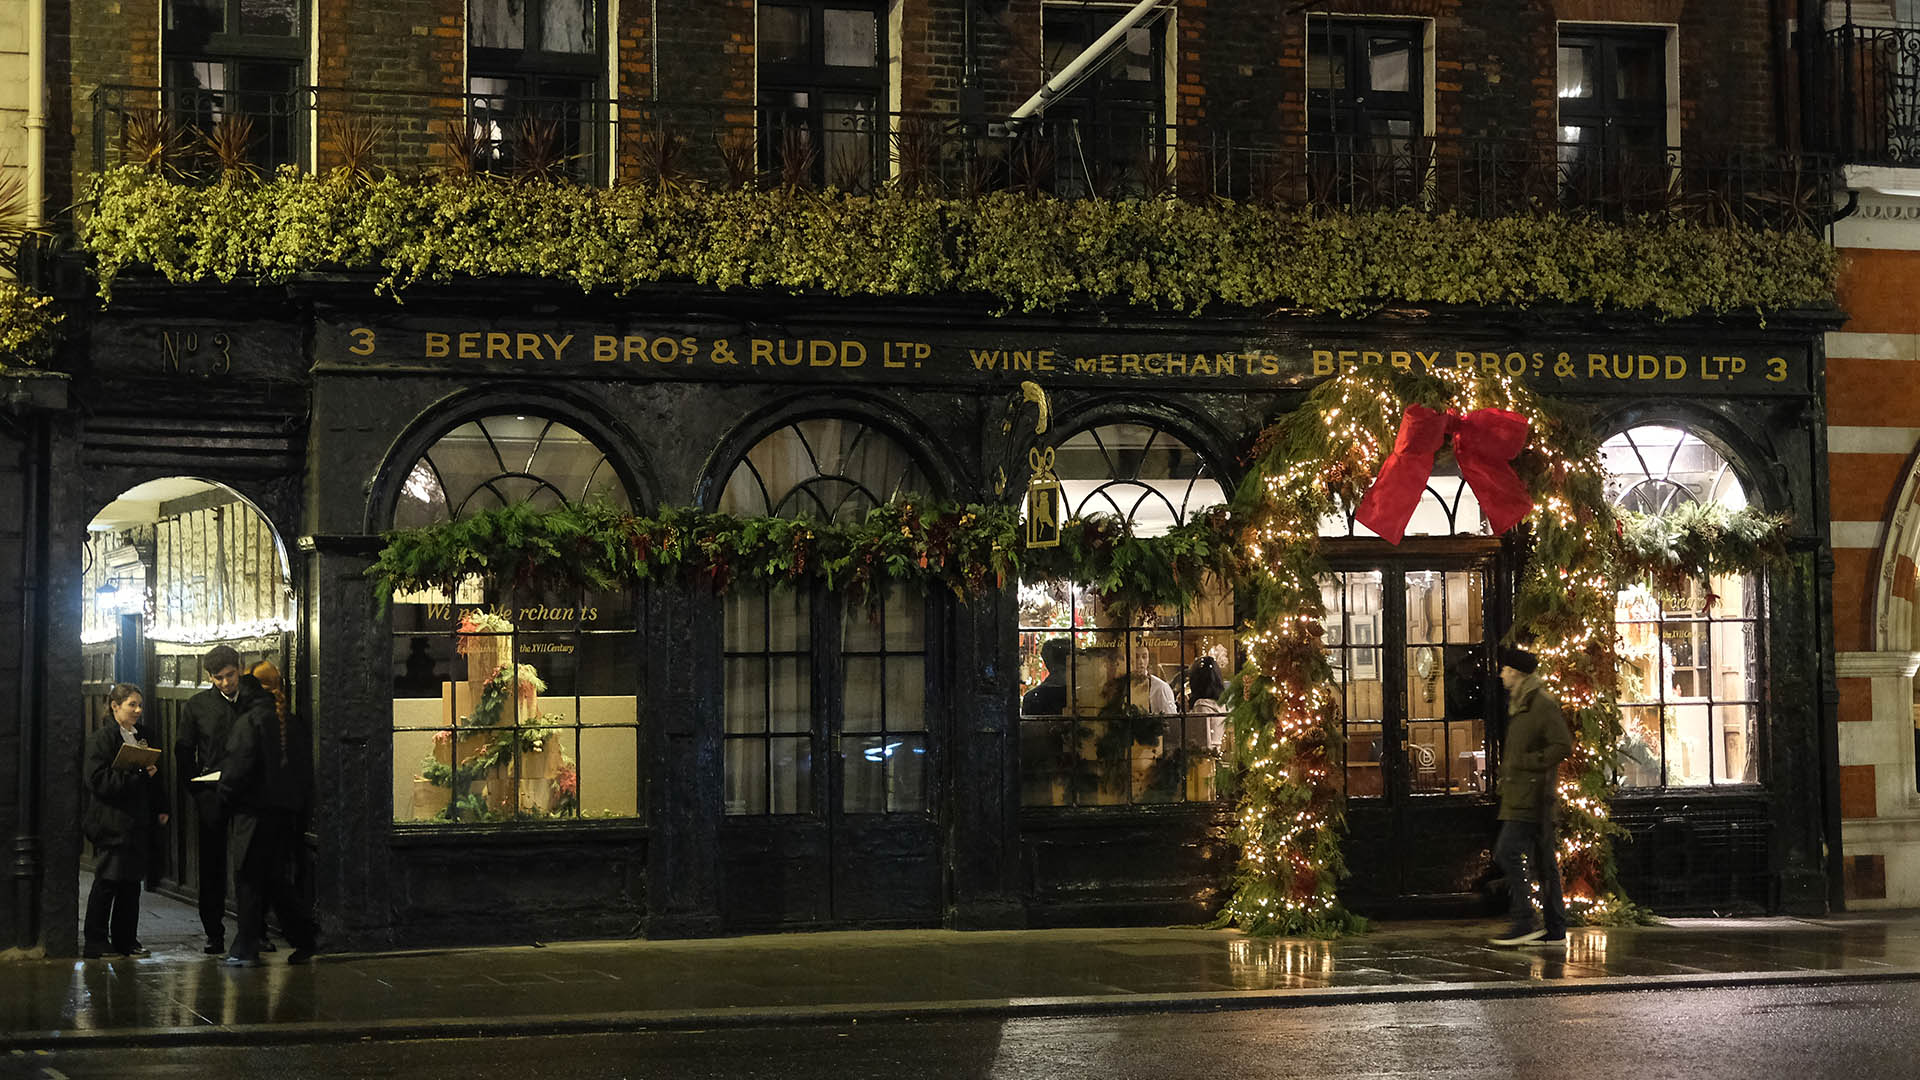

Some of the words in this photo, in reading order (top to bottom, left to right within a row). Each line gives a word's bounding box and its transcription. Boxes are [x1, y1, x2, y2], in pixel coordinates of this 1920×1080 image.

[212, 332, 231, 375] 3
[349, 328, 376, 356] 3
[426, 332, 574, 360] BERRY
[710, 339, 739, 365] &
[751, 339, 867, 367] RUDD
[969, 349, 1056, 371] WINE
[1075, 353, 1279, 376] MERCHANTS
[1553, 352, 1576, 377] &
[1588, 353, 1688, 380] RUDD
[1765, 357, 1788, 382] 3
[547, 643, 575, 654] Century
